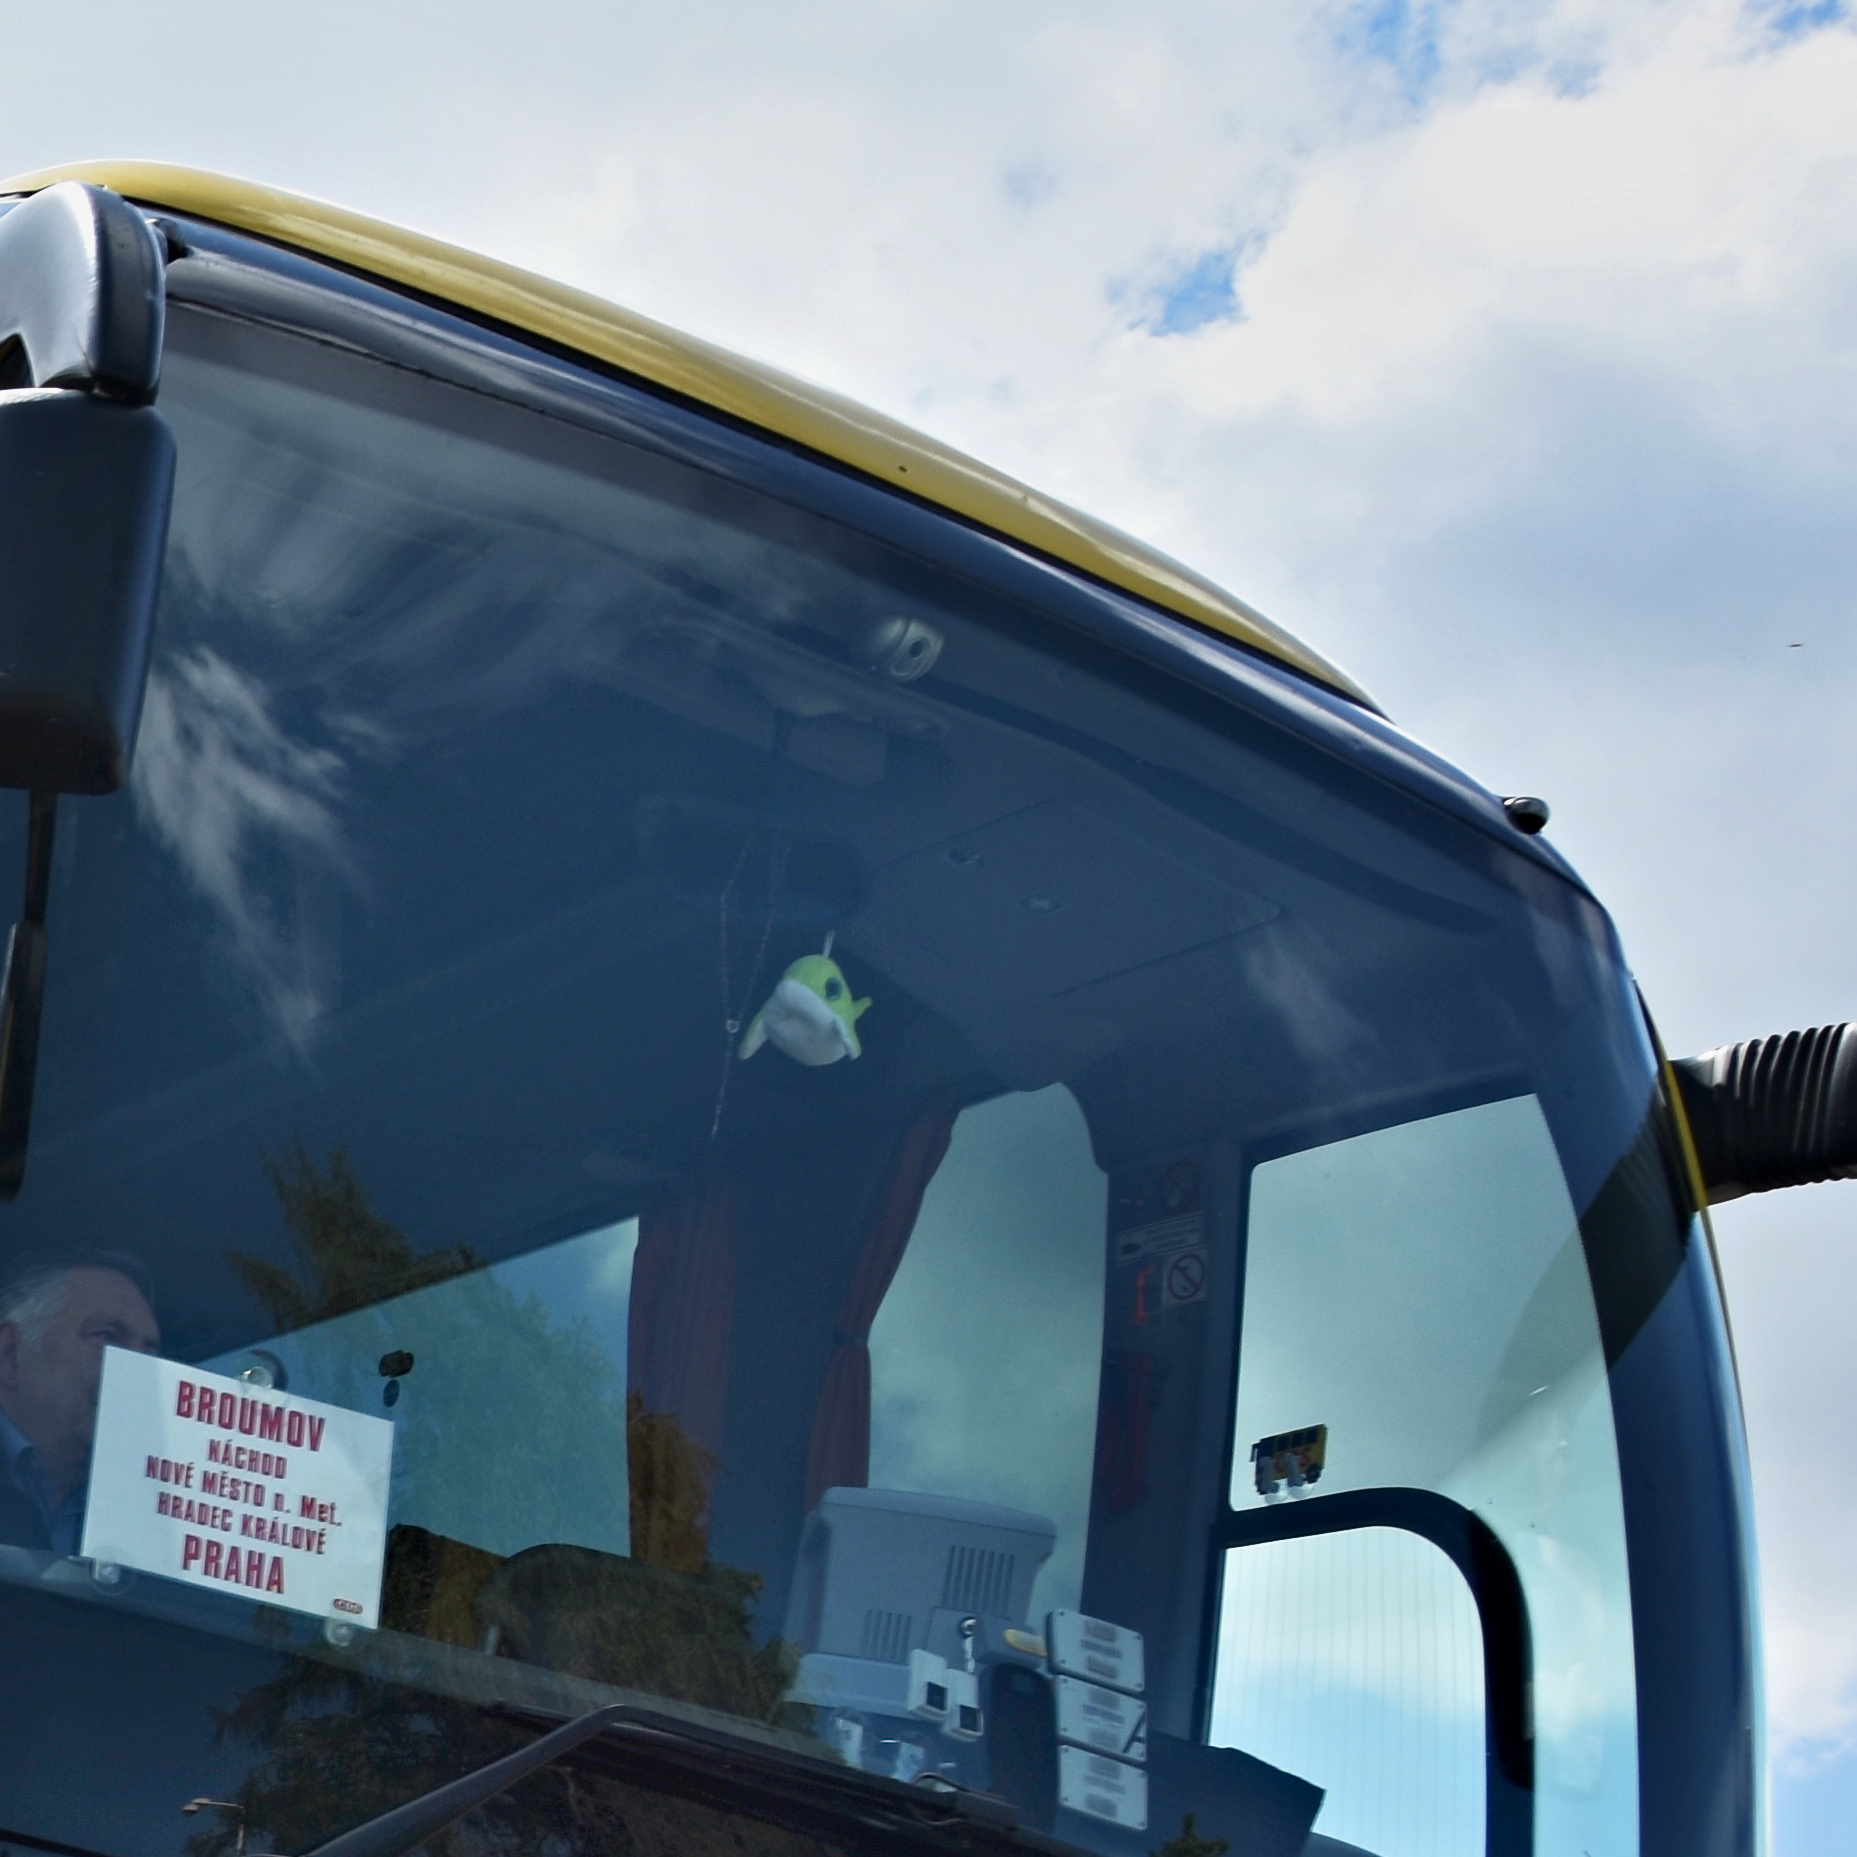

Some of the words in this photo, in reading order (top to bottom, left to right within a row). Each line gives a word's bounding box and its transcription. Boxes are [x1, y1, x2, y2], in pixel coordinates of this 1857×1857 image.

[176, 1380, 326, 1451] BROUMOV
[208, 1438, 287, 1479] NÁCHOD
[146, 1455, 195, 1488] NOVÉ
[202, 1470, 265, 1507] MĚSTO
[274, 1492, 291, 1513] n.
[300, 1495, 342, 1526] Met.
[157, 1491, 233, 1531] HRADEC
[241, 1514, 327, 1554] KRÁLOVÉ
[182, 1534, 285, 1594] PRAHA
